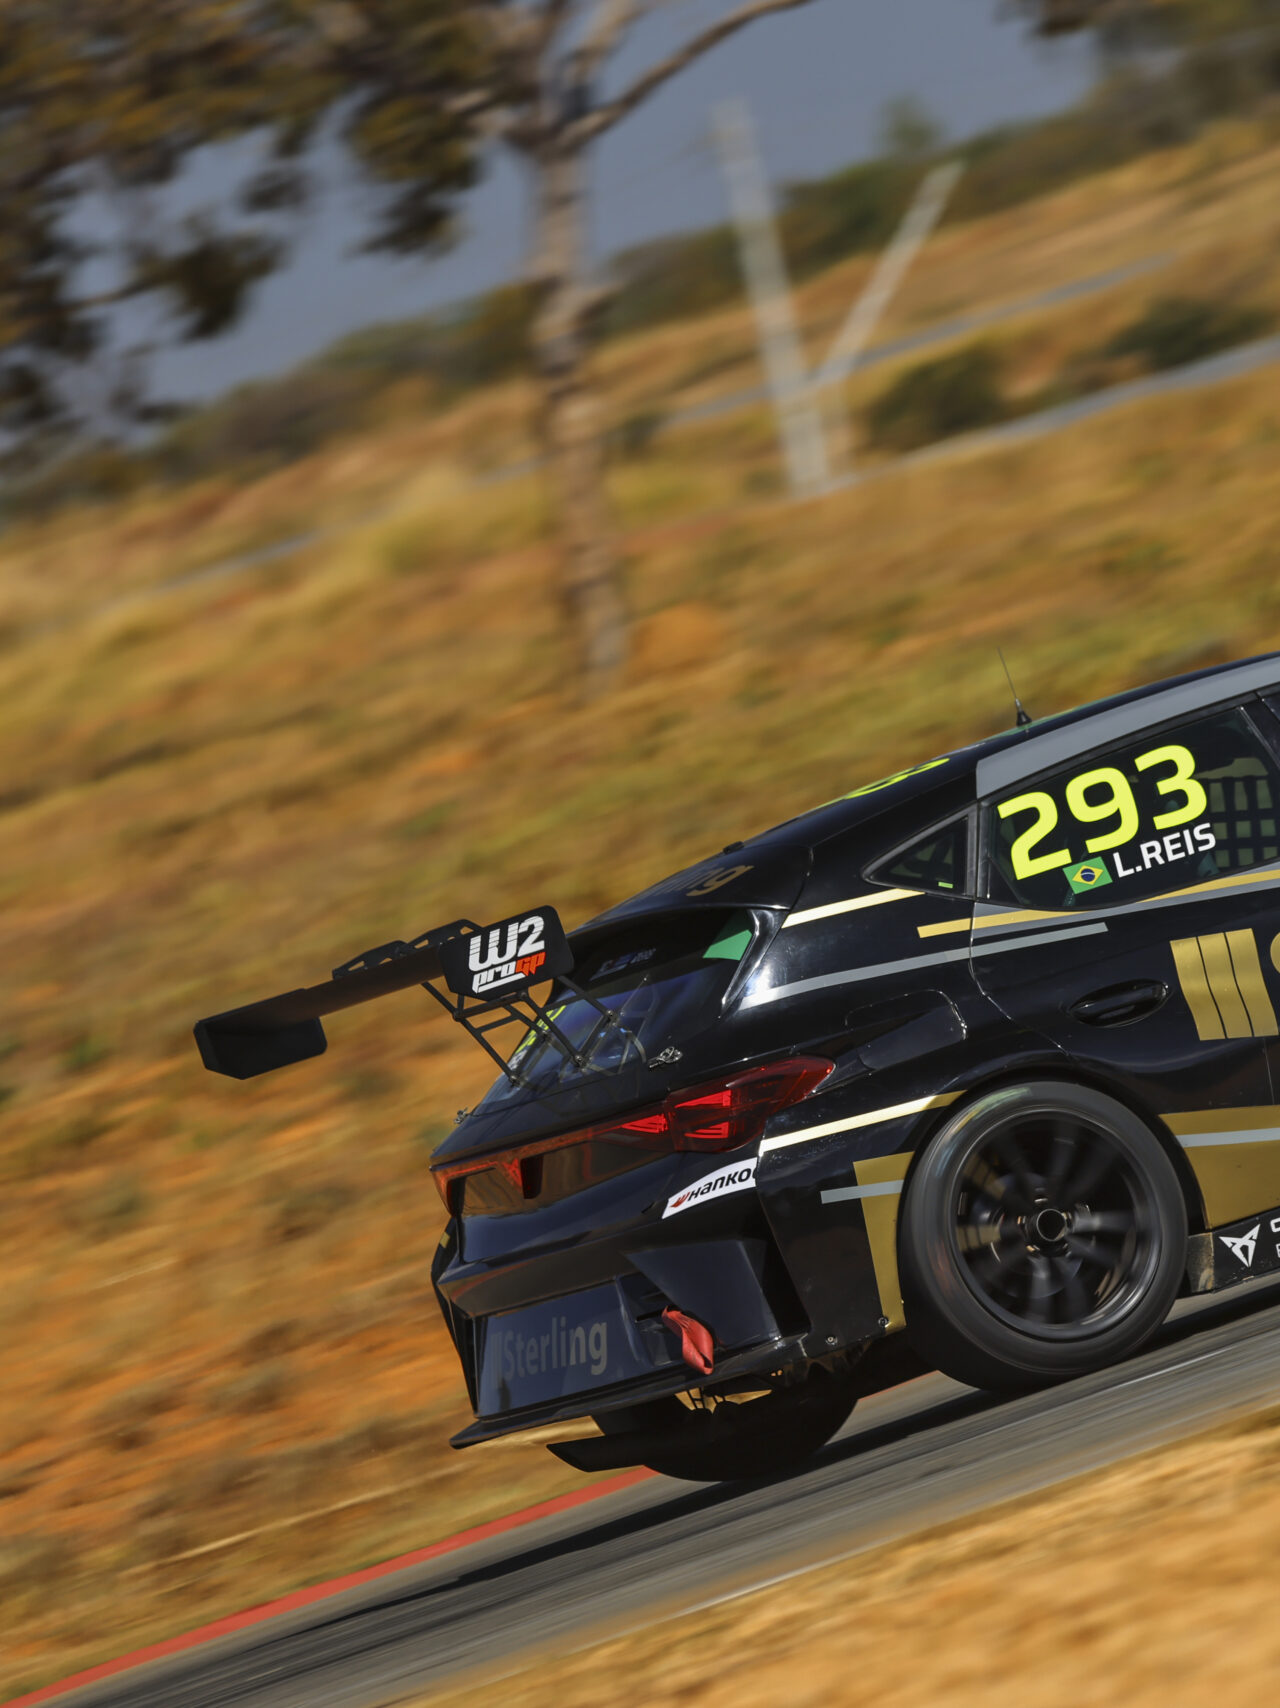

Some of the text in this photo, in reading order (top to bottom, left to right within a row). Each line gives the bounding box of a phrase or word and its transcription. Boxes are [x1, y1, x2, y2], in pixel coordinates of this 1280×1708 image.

[997, 744, 1207, 880] 293
[1113, 823, 1216, 878] L.REIS
[468, 915, 545, 972] W2
[687, 1167, 757, 1202] Hanko
[503, 1315, 608, 1381] Sterling
